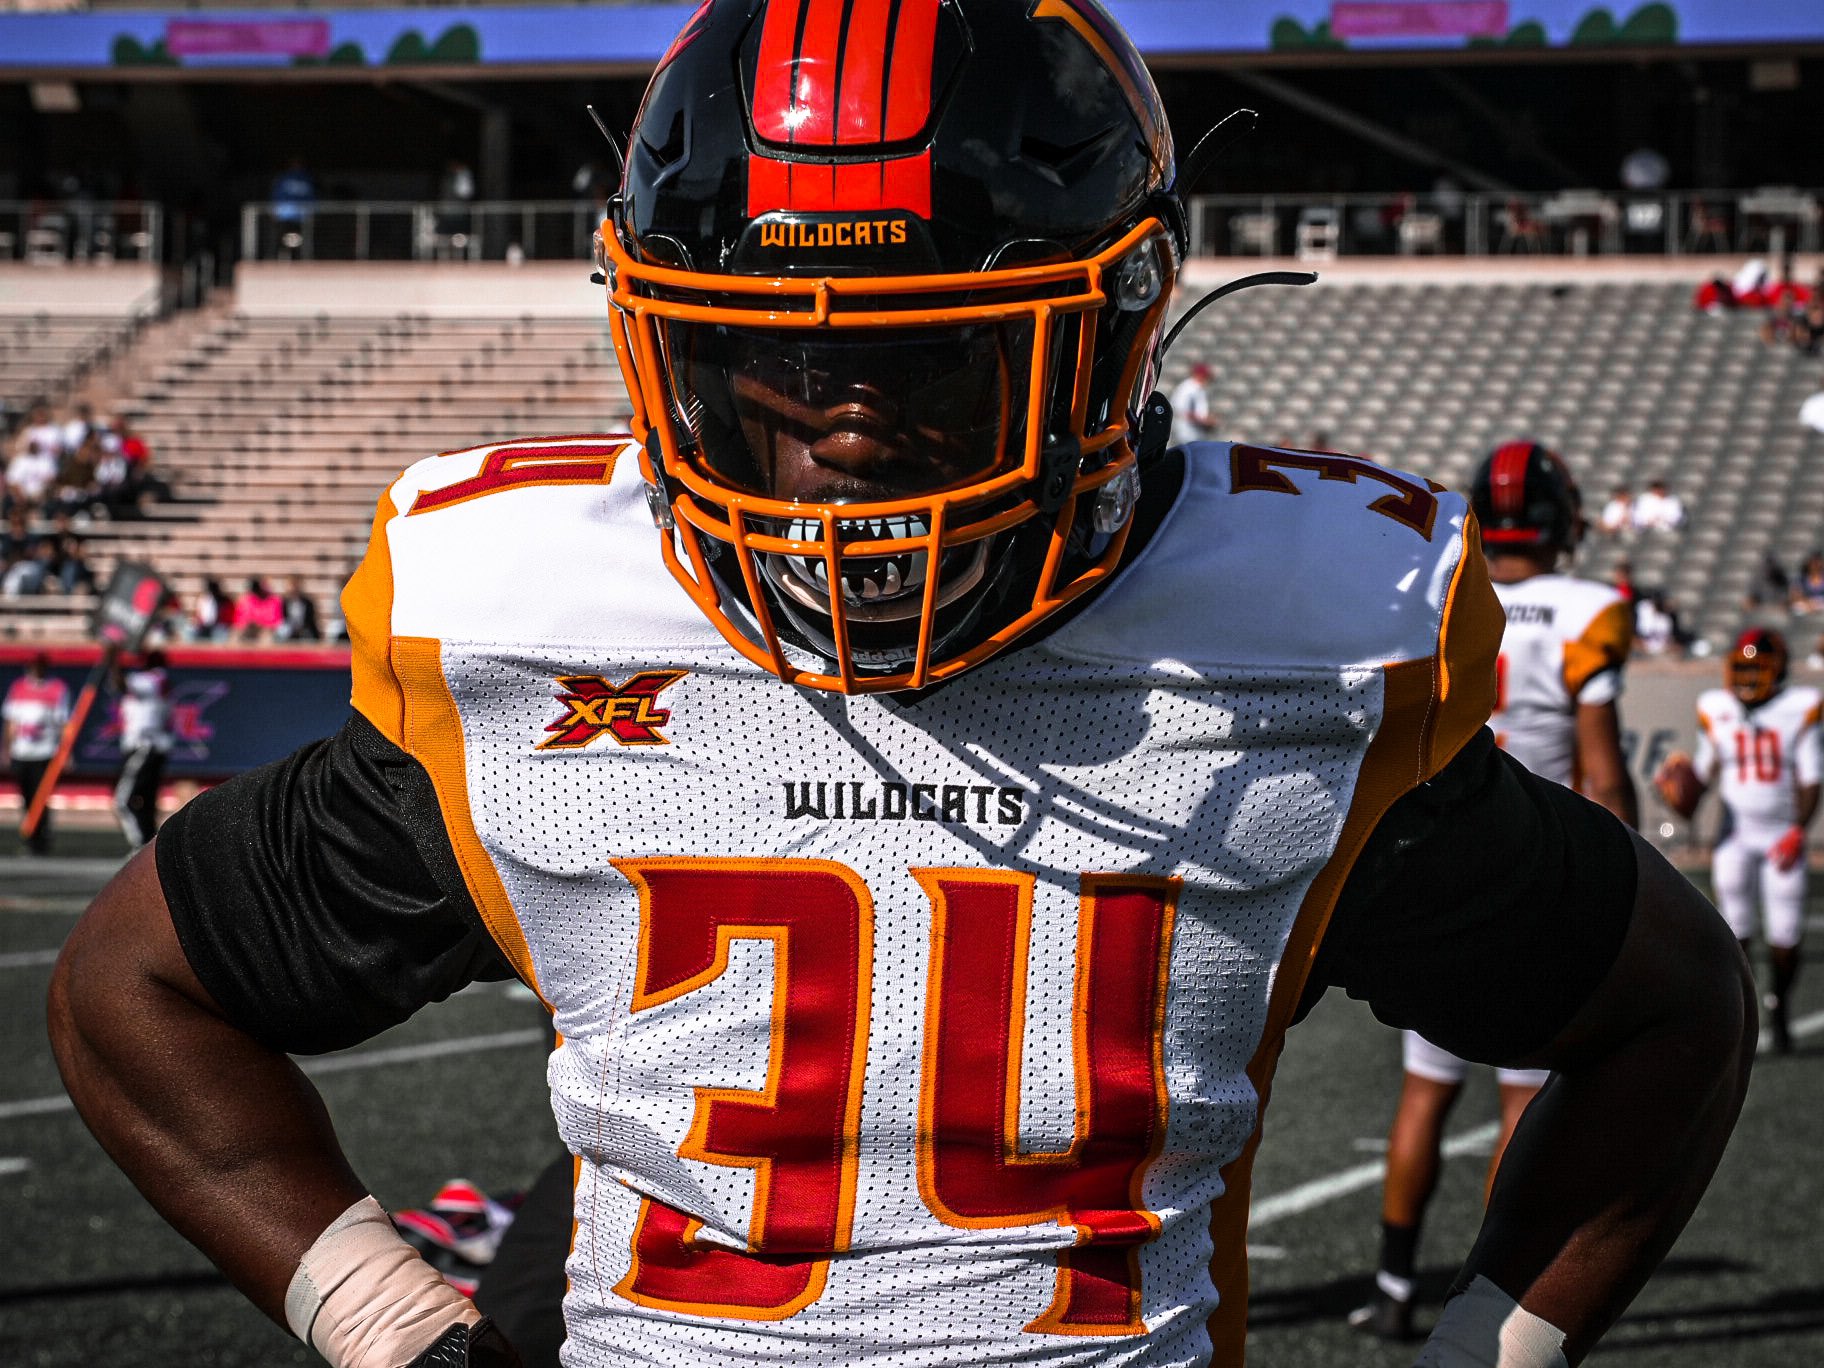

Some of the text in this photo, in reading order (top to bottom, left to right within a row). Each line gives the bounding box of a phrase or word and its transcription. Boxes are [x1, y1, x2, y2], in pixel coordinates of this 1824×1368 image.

[760, 219, 907, 247] WILDCATS
[1733, 728, 1782, 783] 10
[782, 781, 1025, 825] WILDCATS
[609, 856, 1182, 1336] 34
